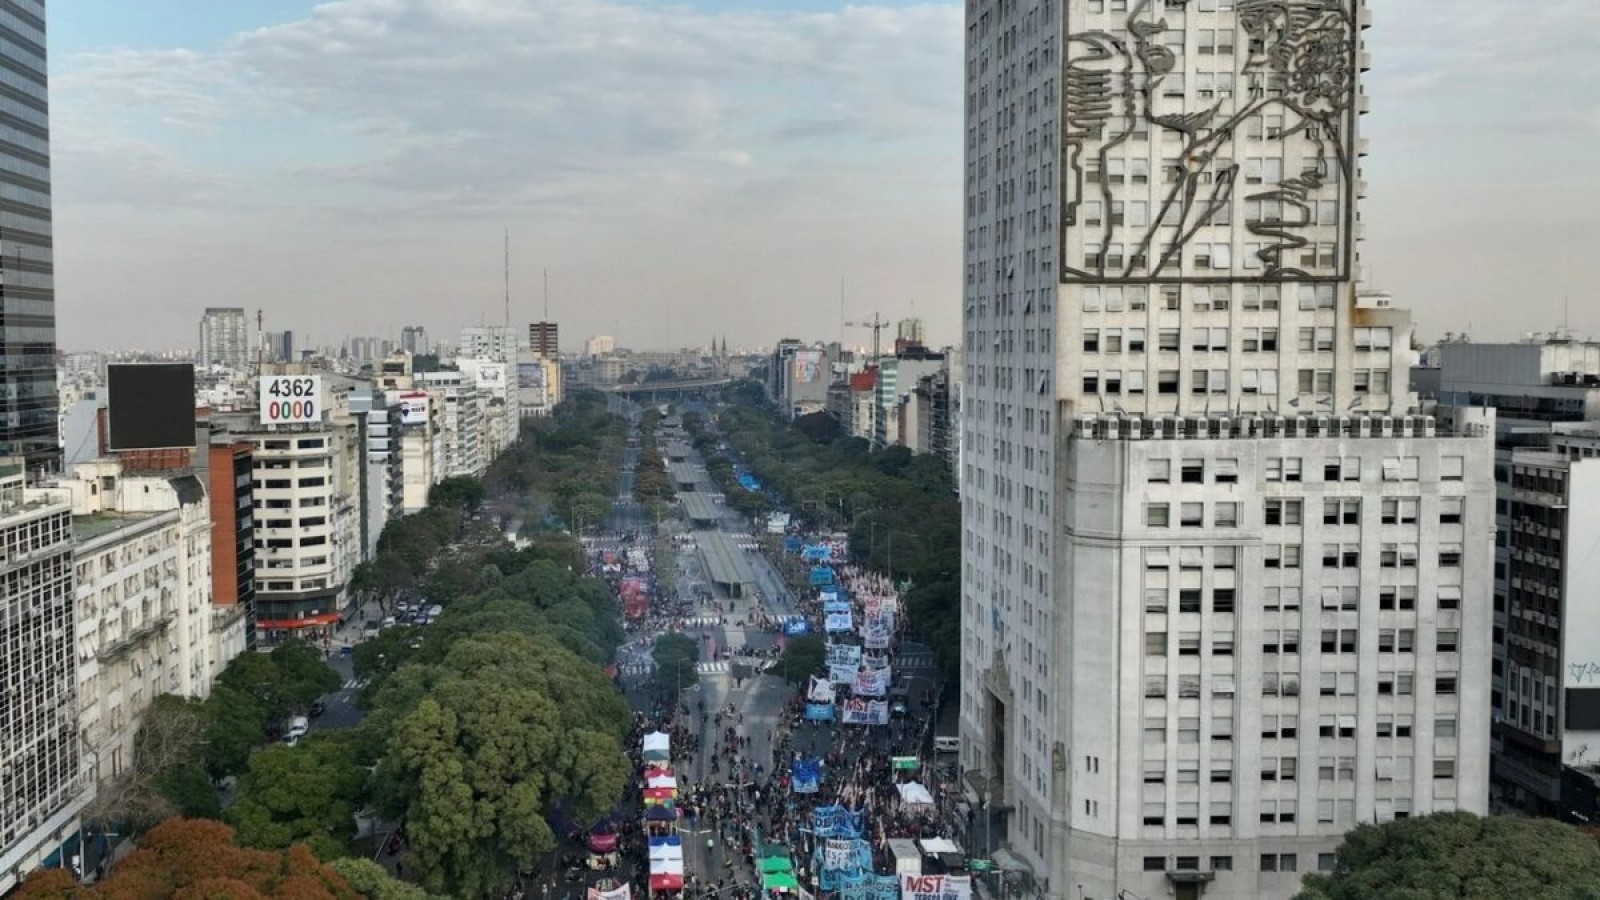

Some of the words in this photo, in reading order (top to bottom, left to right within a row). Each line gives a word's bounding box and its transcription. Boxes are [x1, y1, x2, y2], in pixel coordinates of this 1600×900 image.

[269, 379, 314, 397] 4362
[269, 400, 314, 420] 0000
[906, 875, 944, 893] MST
